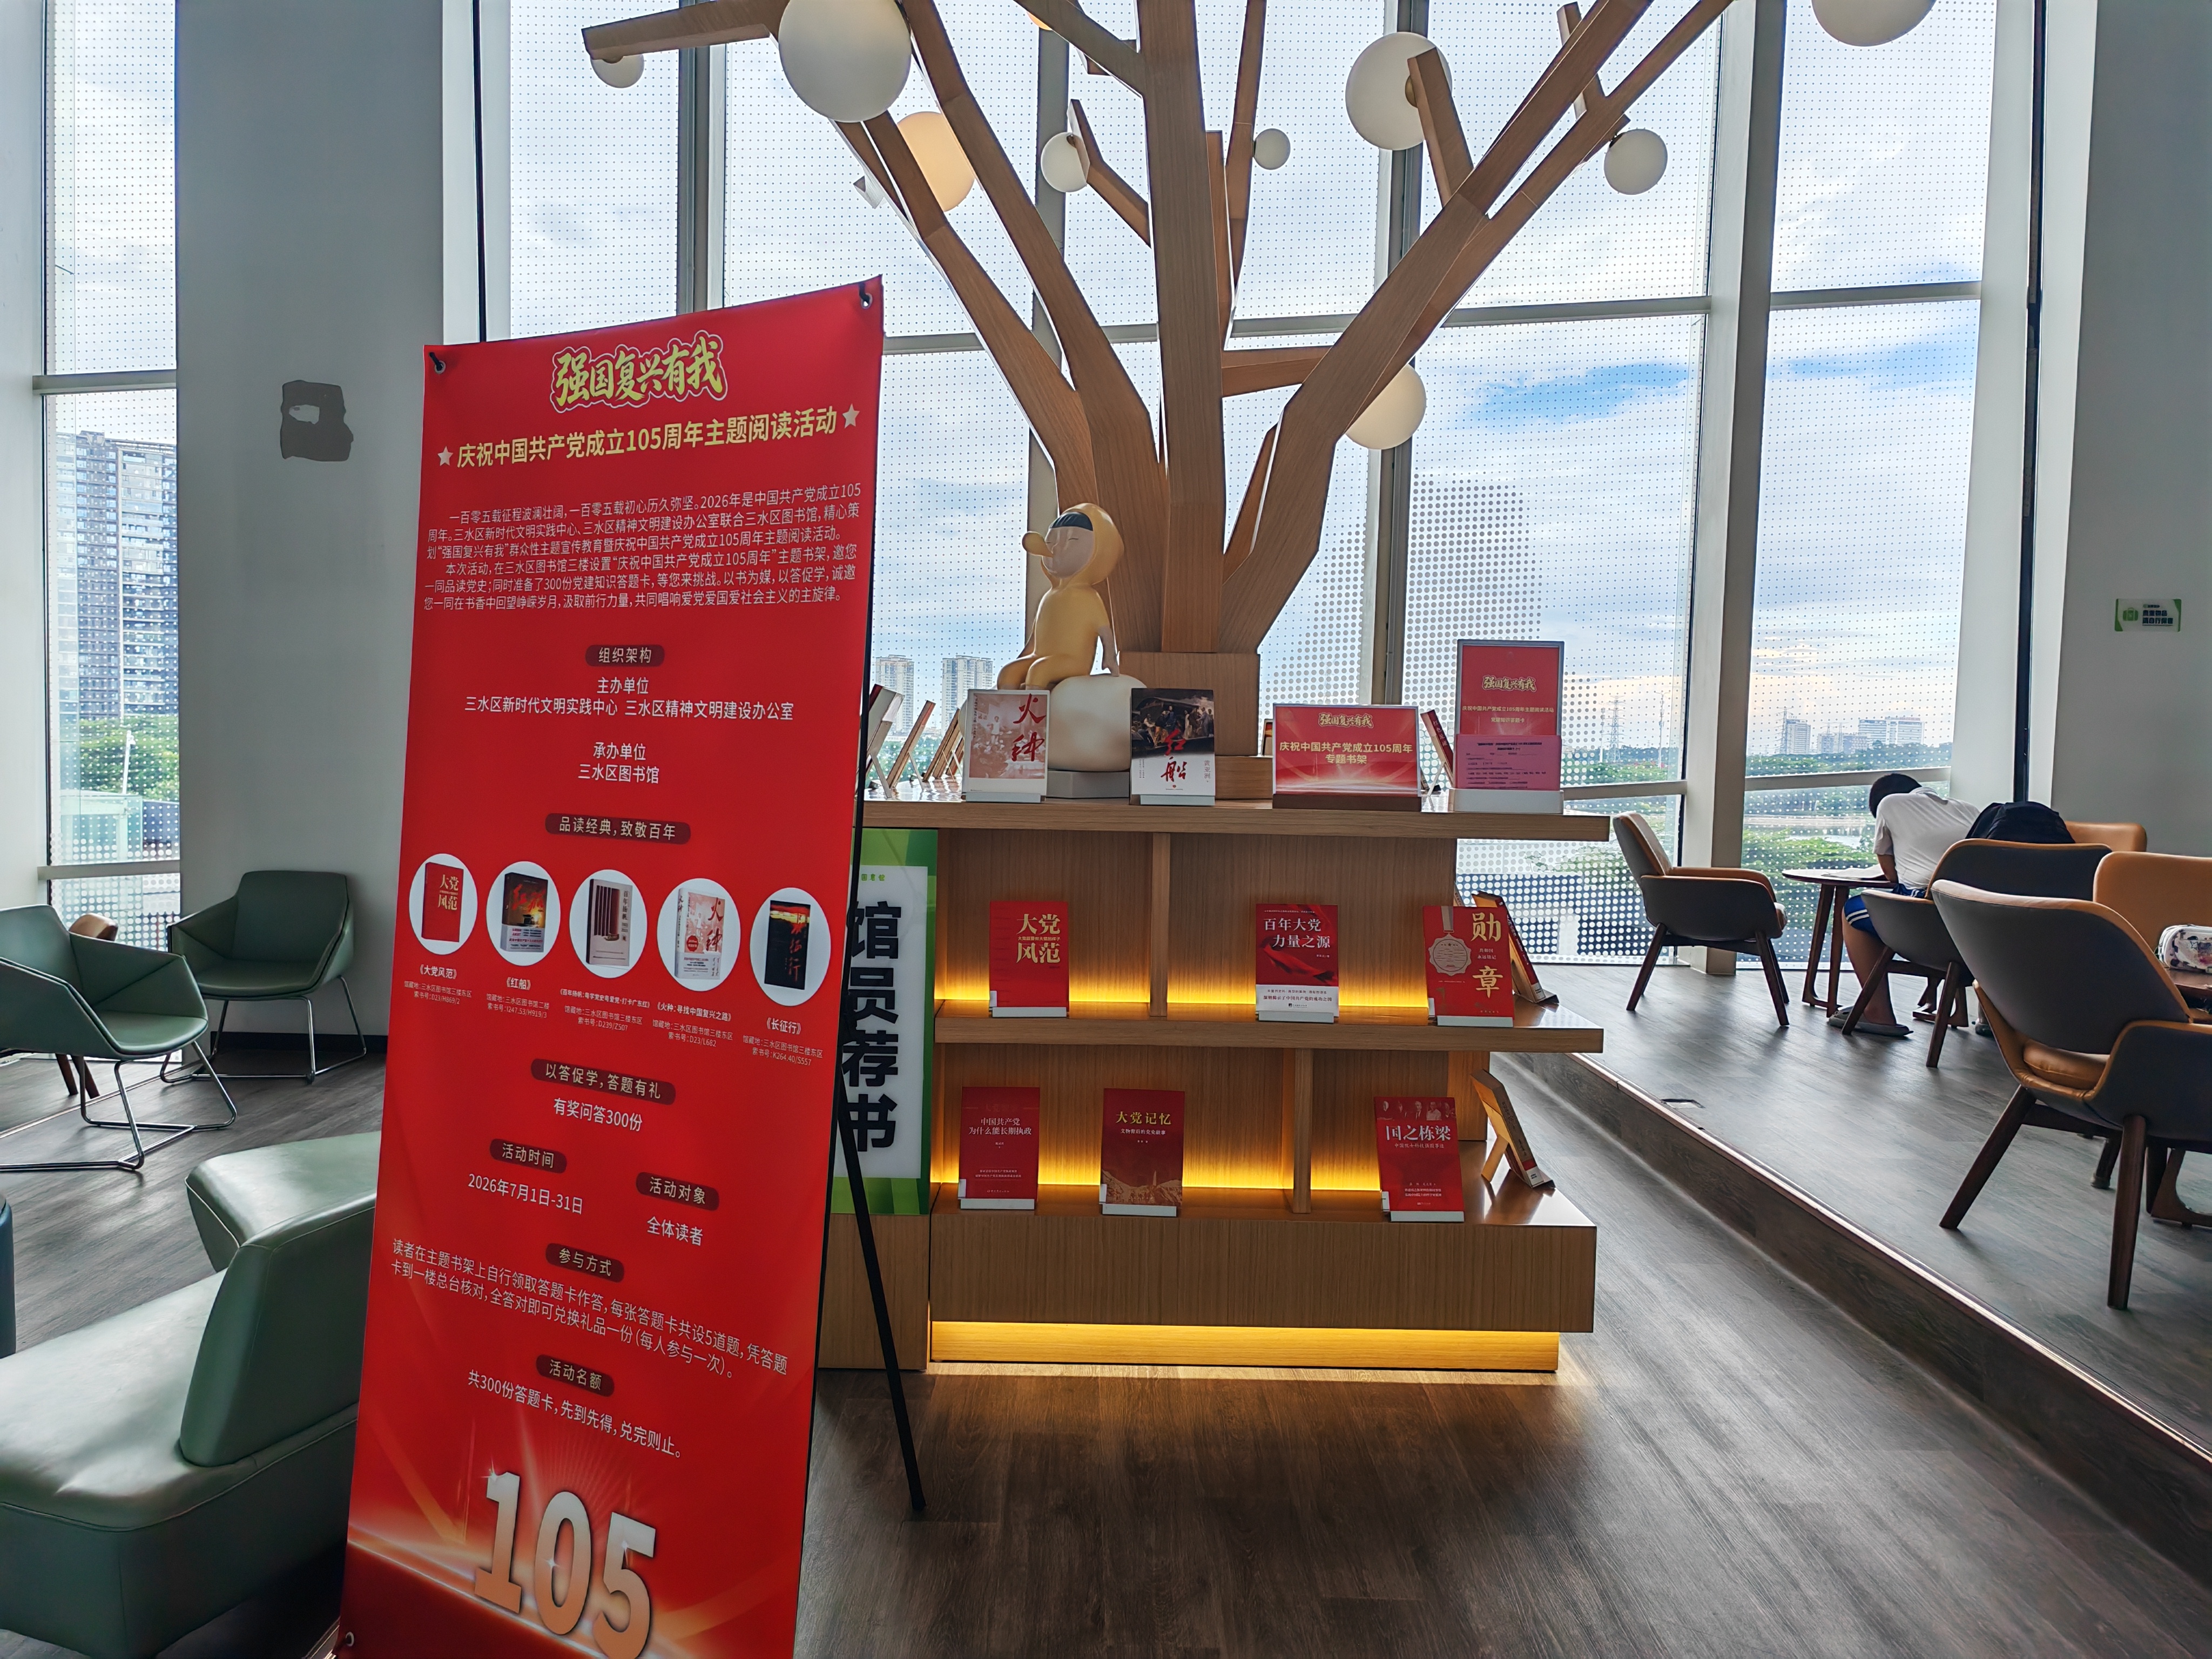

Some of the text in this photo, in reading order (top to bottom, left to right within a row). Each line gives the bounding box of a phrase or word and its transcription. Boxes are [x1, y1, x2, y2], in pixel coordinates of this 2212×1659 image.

[553, 334, 724, 408] 强国复兴有我
[457, 406, 837, 468] 庆祝中国共产党成立105周年主题阅读活动
[598, 647, 652, 664] 组织架构
[596, 677, 649, 694] 主办单位
[1483, 676, 1536, 692] 强国复兴有我
[464, 695, 794, 721] 三水区新时代文明实践中心 三水区精神文明建设办公室
[1318, 712, 1373, 728] 强国复兴有我
[593, 741, 646, 761] 承办单位
[1160, 728, 1188, 783] 红船
[1279, 740, 1413, 754] 庆祝中国共产党成立105周年
[1325, 753, 1367, 765] 专题书架
[577, 763, 660, 784] 三水区图书馆
[558, 815, 676, 841] 品读经典，致敬百年
[440, 874, 460, 892] 大党
[437, 893, 458, 911] 风范
[1016, 913, 1061, 935] 大党
[1263, 918, 1321, 932] 百年大党
[1272, 934, 1331, 949] 力量之源
[1016, 942, 1061, 963] 风范
[420, 964, 457, 979] 《大党风范》
[507, 976, 531, 990] 《红船》
[766, 1017, 802, 1035] 《长征行》
[841, 900, 902, 1153] 馆员荐书
[544, 1062, 662, 1101] 以答促学，答题有礼
[553, 1097, 644, 1132] 有奖问答300份
[980, 1117, 1021, 1127] 中国共产党
[1115, 1111, 1172, 1125] 大党记忆
[968, 1127, 1032, 1136] 为什么能长期执政
[1385, 1125, 1452, 1142] 国之栋梁
[502, 1142, 555, 1169] 活动时间
[467, 1173, 584, 1216] 2026年7月1日-31日
[649, 1176, 706, 1205] 活动对象
[646, 1216, 704, 1246] 全体读者
[558, 1247, 612, 1277] 参与方式
[548, 1359, 603, 1390] 活动名额
[473, 1471, 657, 1658] 105
